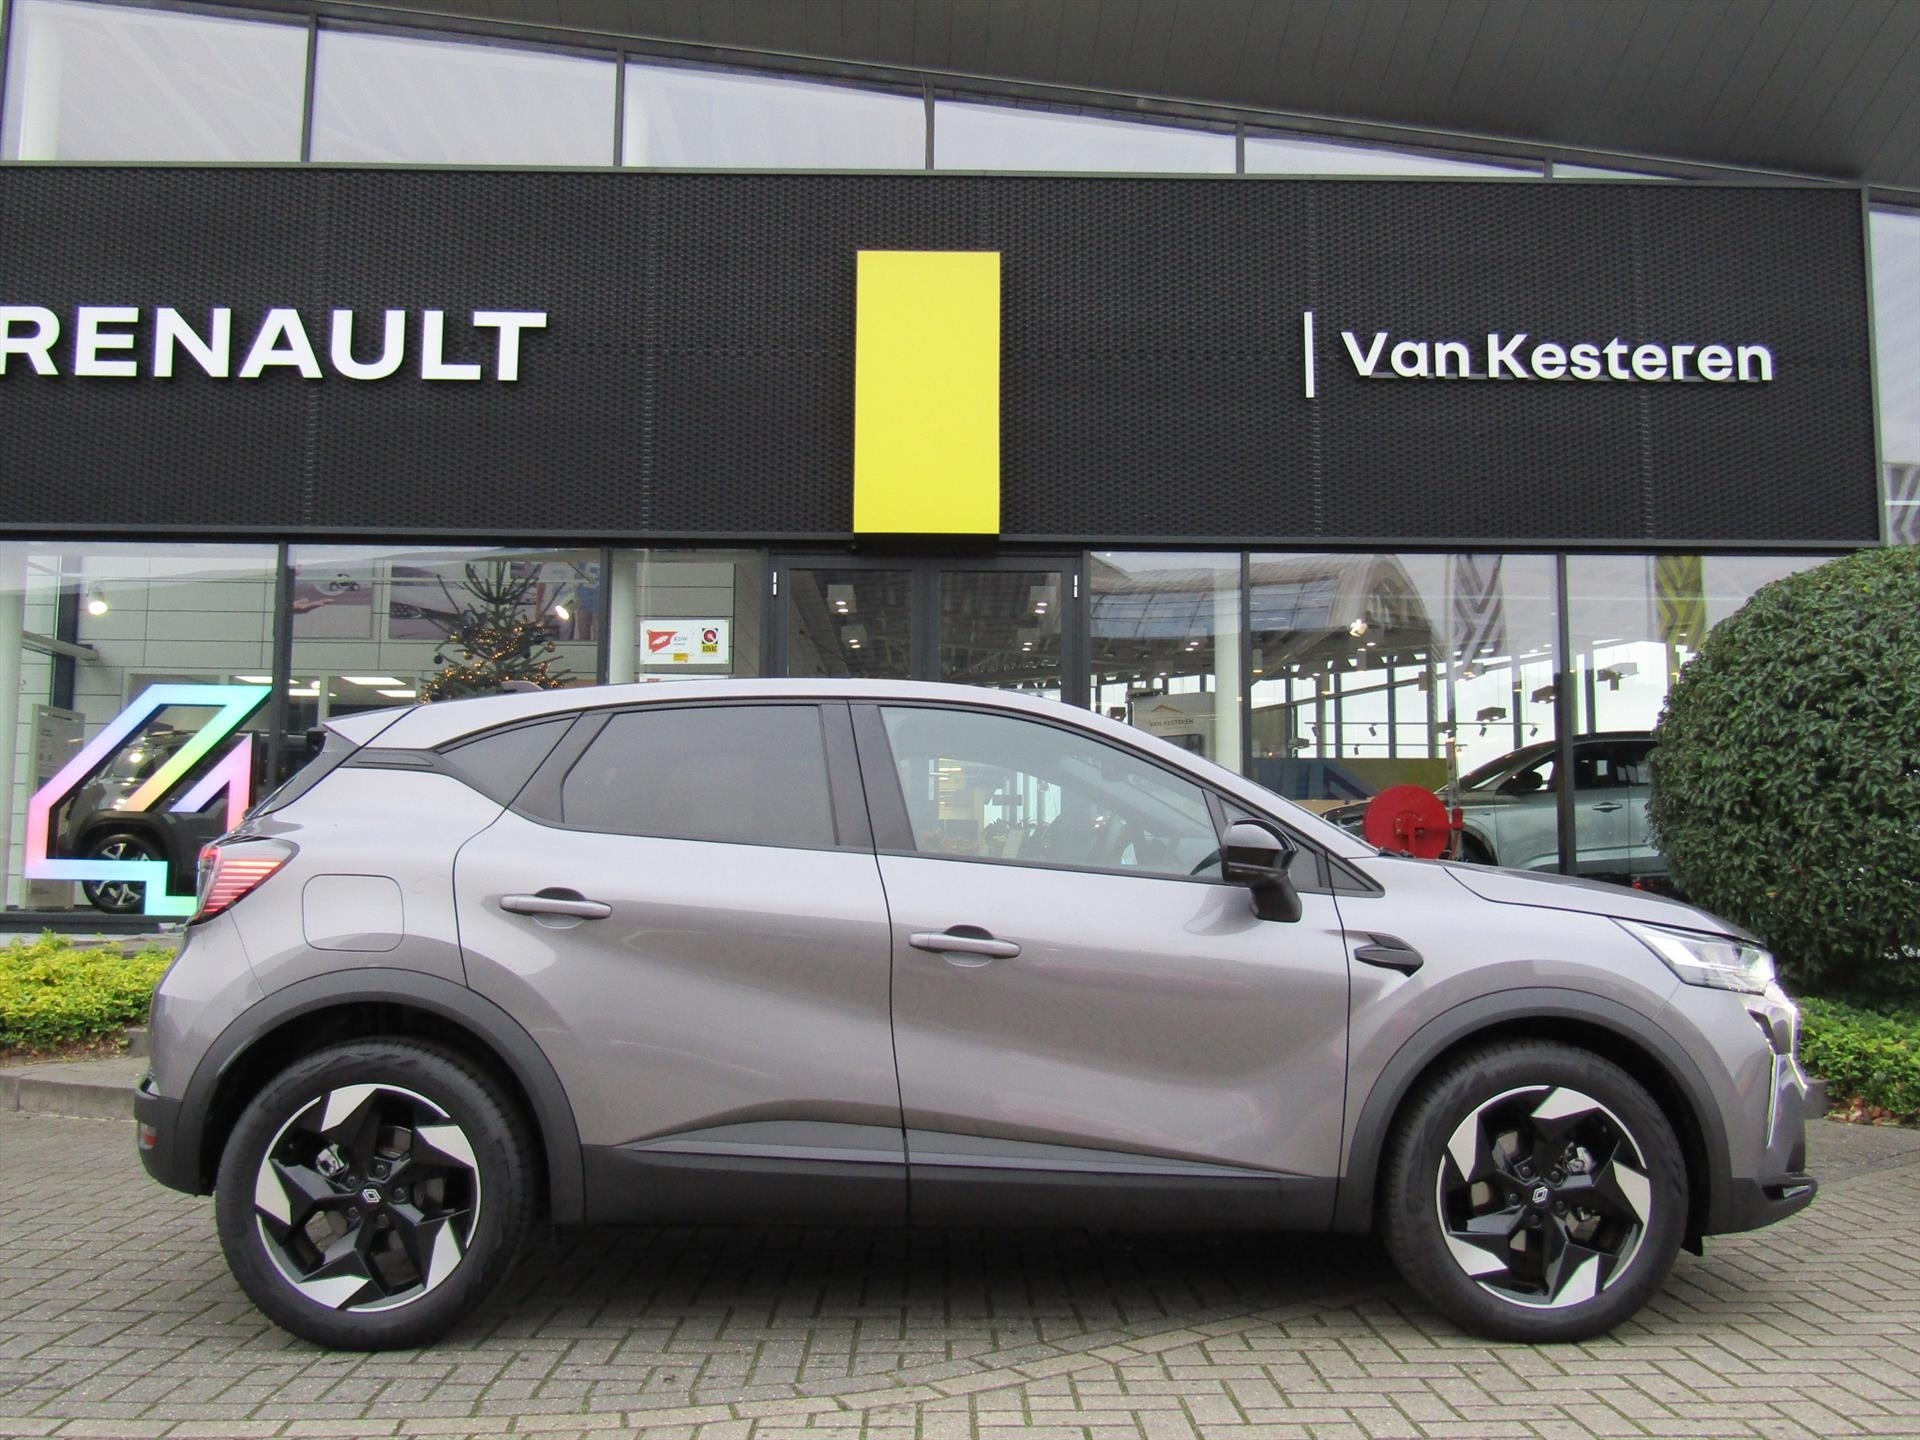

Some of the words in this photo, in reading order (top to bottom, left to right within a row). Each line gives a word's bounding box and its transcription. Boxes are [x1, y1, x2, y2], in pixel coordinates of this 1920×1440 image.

[0, 306, 548, 381] RENAULT
[1340, 331, 1471, 379] Van
[1487, 333, 1773, 382] Kesteren
